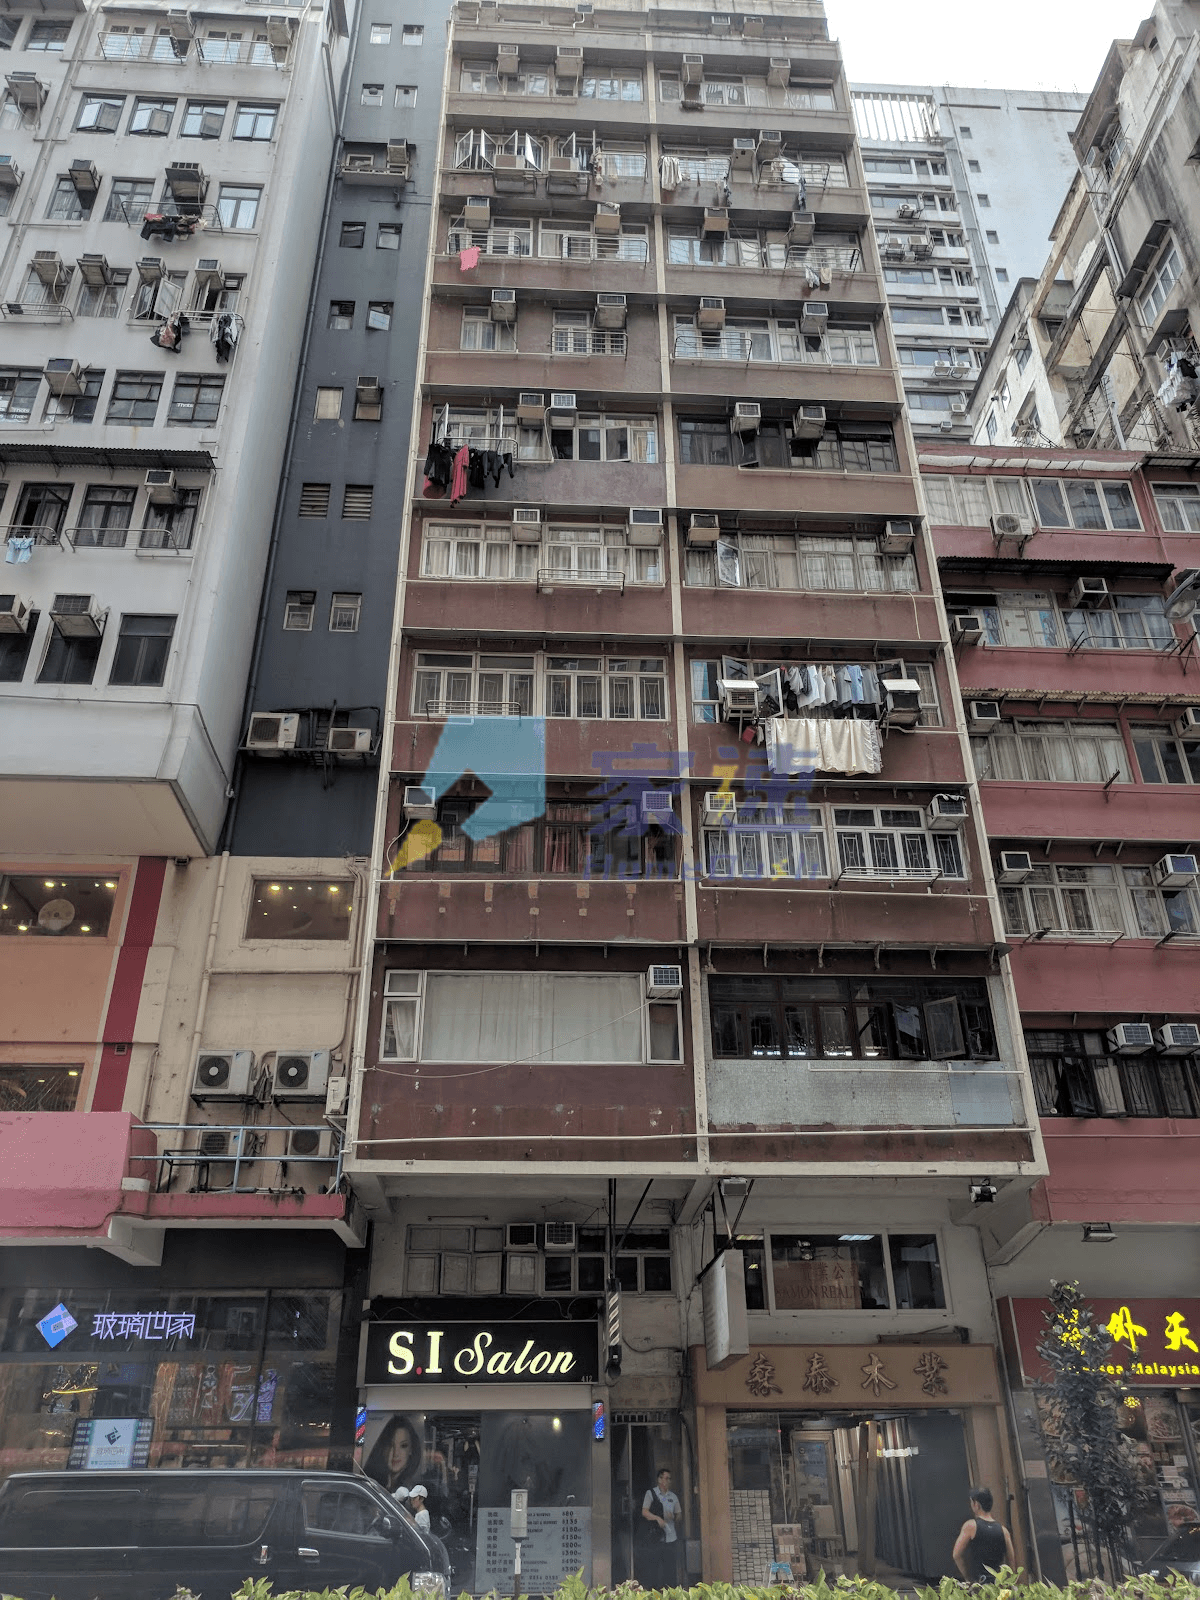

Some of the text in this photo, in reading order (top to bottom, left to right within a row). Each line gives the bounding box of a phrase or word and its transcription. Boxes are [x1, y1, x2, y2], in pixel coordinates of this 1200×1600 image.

[91, 1311, 196, 1340] 玻璃世家
[387, 1330, 577, 1375] S.I Salon
[580, 1375, 593, 1383] 412
